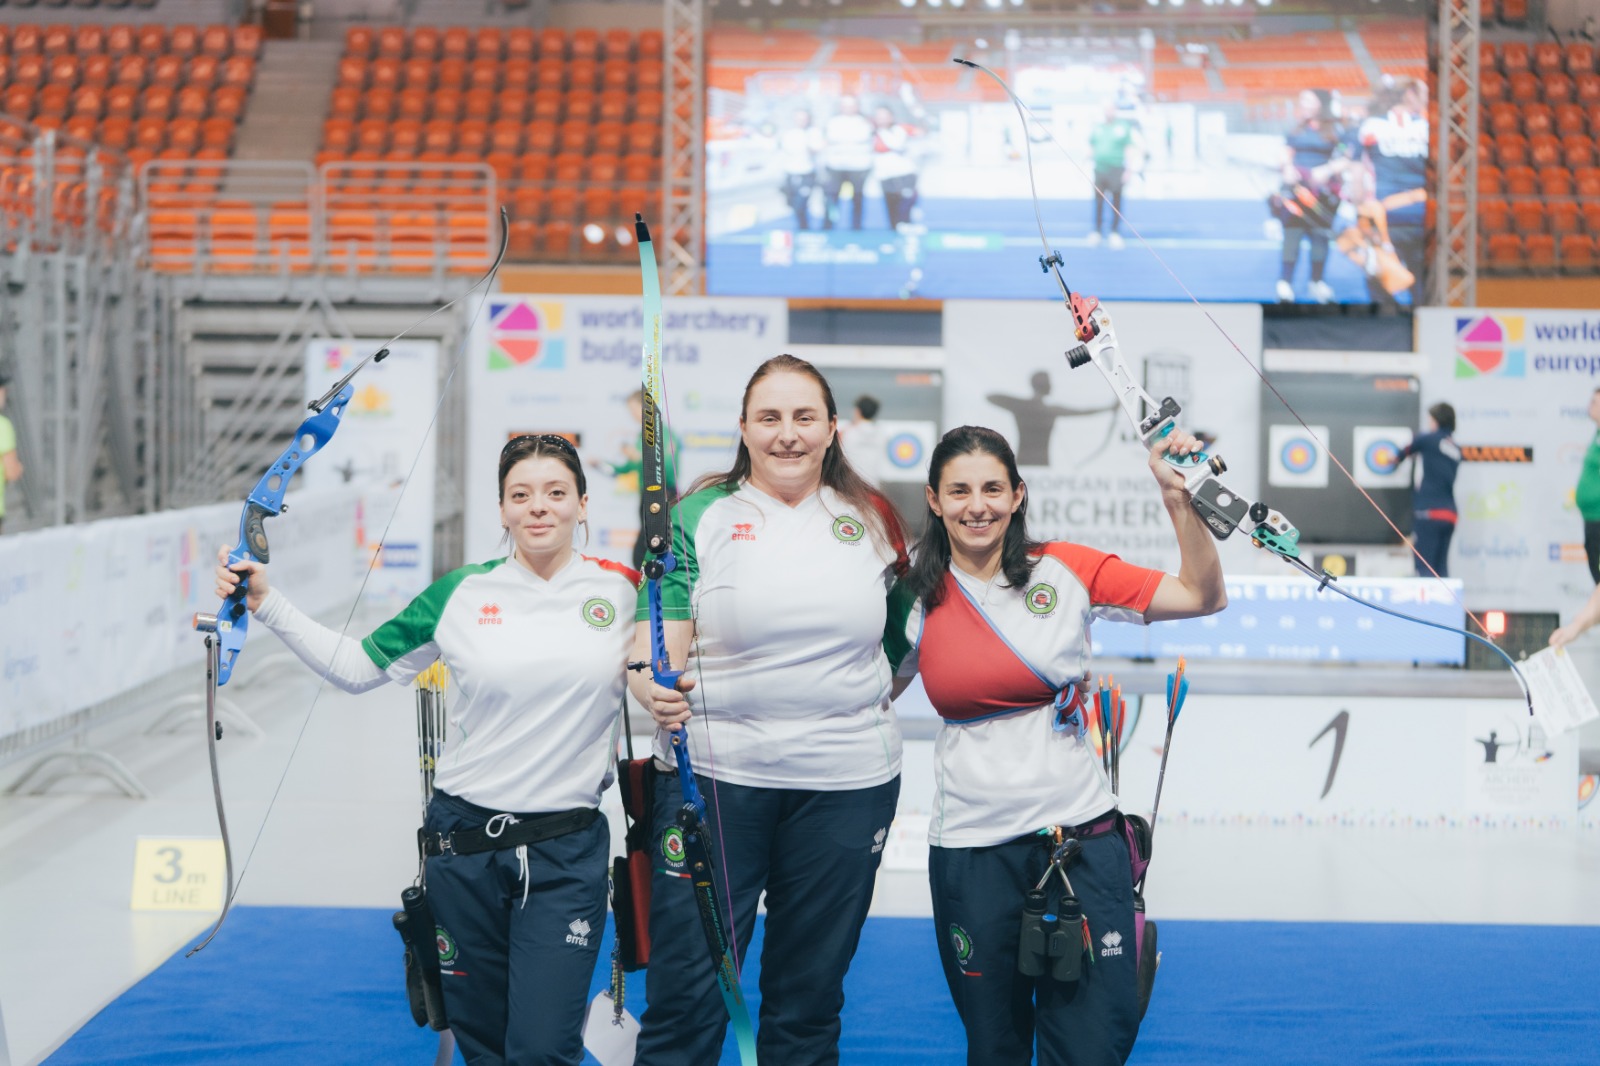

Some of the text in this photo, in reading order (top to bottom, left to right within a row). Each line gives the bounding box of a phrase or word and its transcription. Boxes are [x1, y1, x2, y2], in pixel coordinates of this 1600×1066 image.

[665, 308, 769, 336] archery
[580, 337, 700, 369] bulgria
[644, 390, 655, 448] GILLO
[1308, 708, 1350, 800] 1
[152, 846, 207, 885] 3 m
[152, 889, 201, 905] LINE
